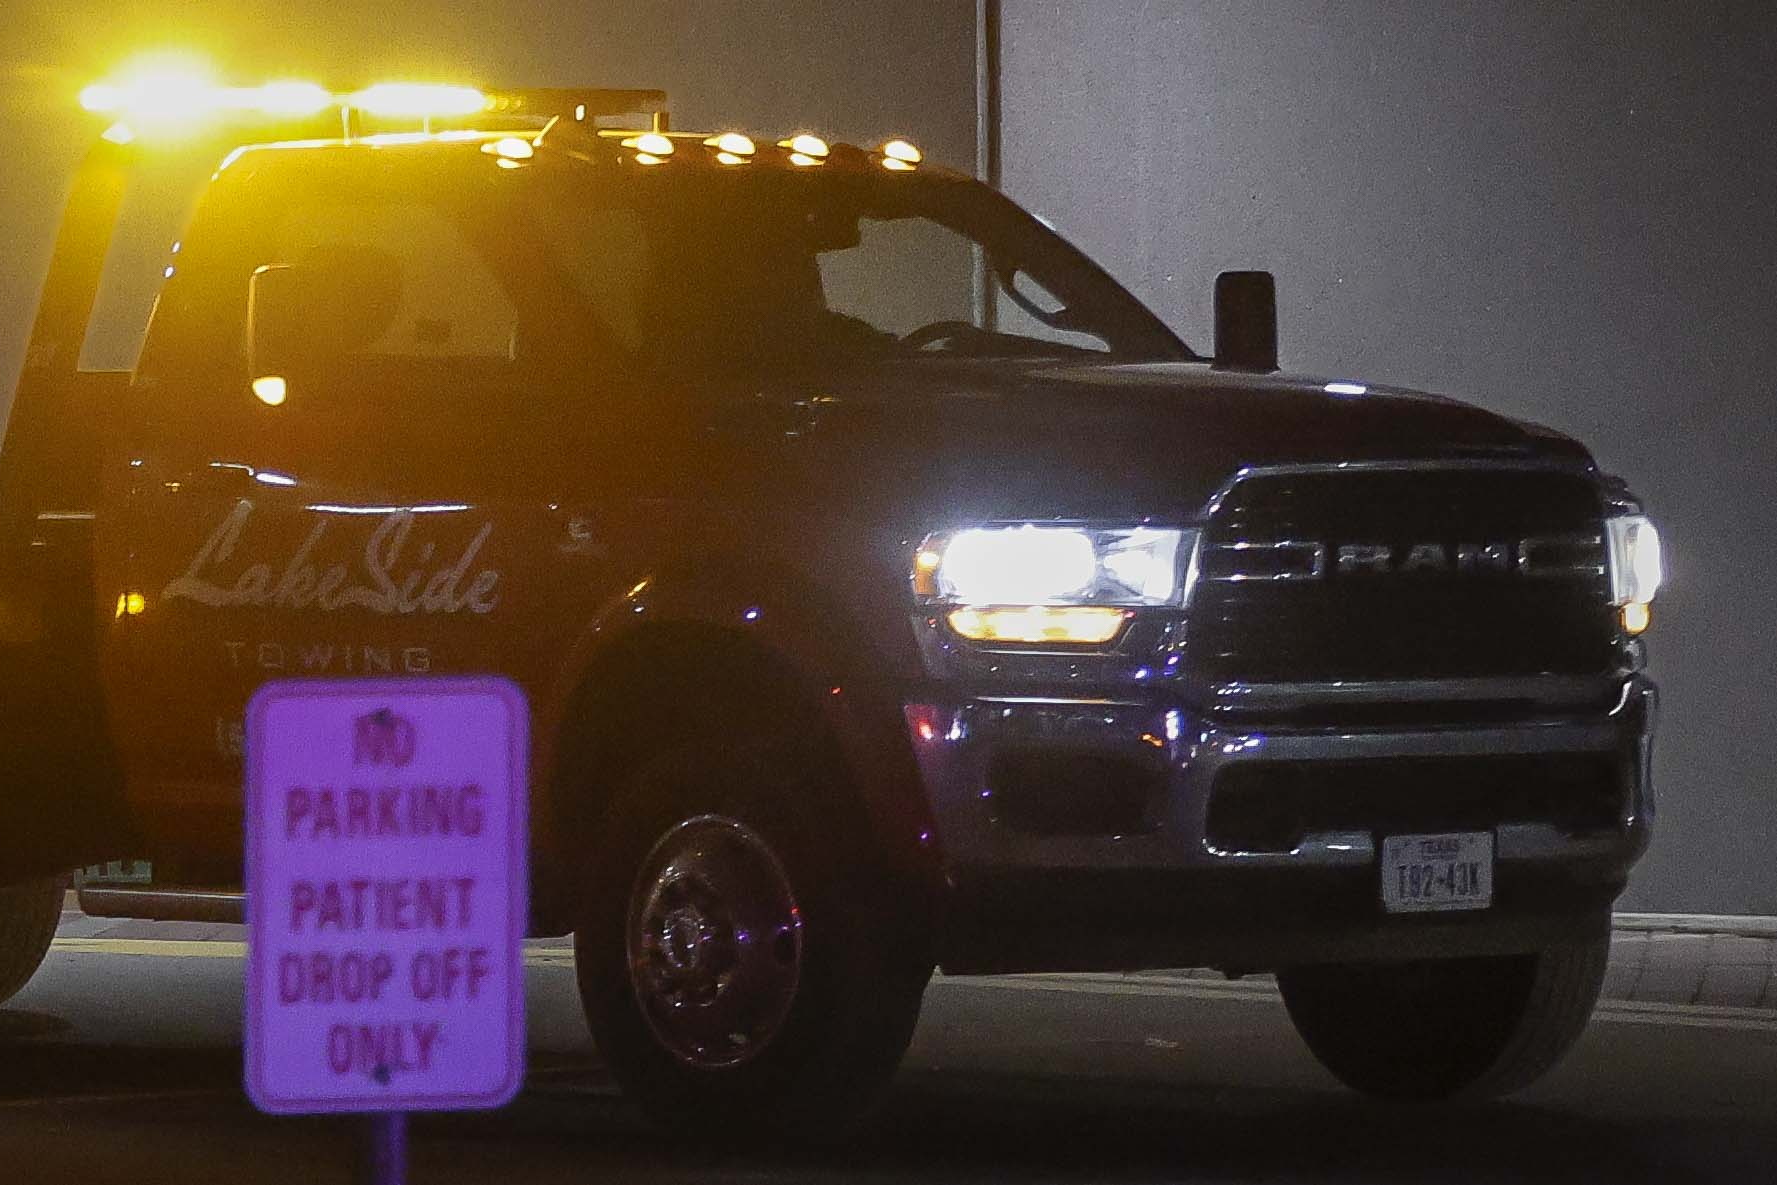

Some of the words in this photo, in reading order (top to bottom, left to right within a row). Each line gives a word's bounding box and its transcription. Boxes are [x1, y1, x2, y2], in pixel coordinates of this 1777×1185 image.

[1338, 543, 1508, 572] RAM
[225, 642, 432, 673] TOWING
[353, 714, 417, 768] NO
[283, 783, 486, 839] PARKING
[289, 877, 476, 933] PATIENT
[278, 951, 393, 1005] DROP
[410, 948, 490, 1002] OFF
[329, 1023, 442, 1075] ONLY
